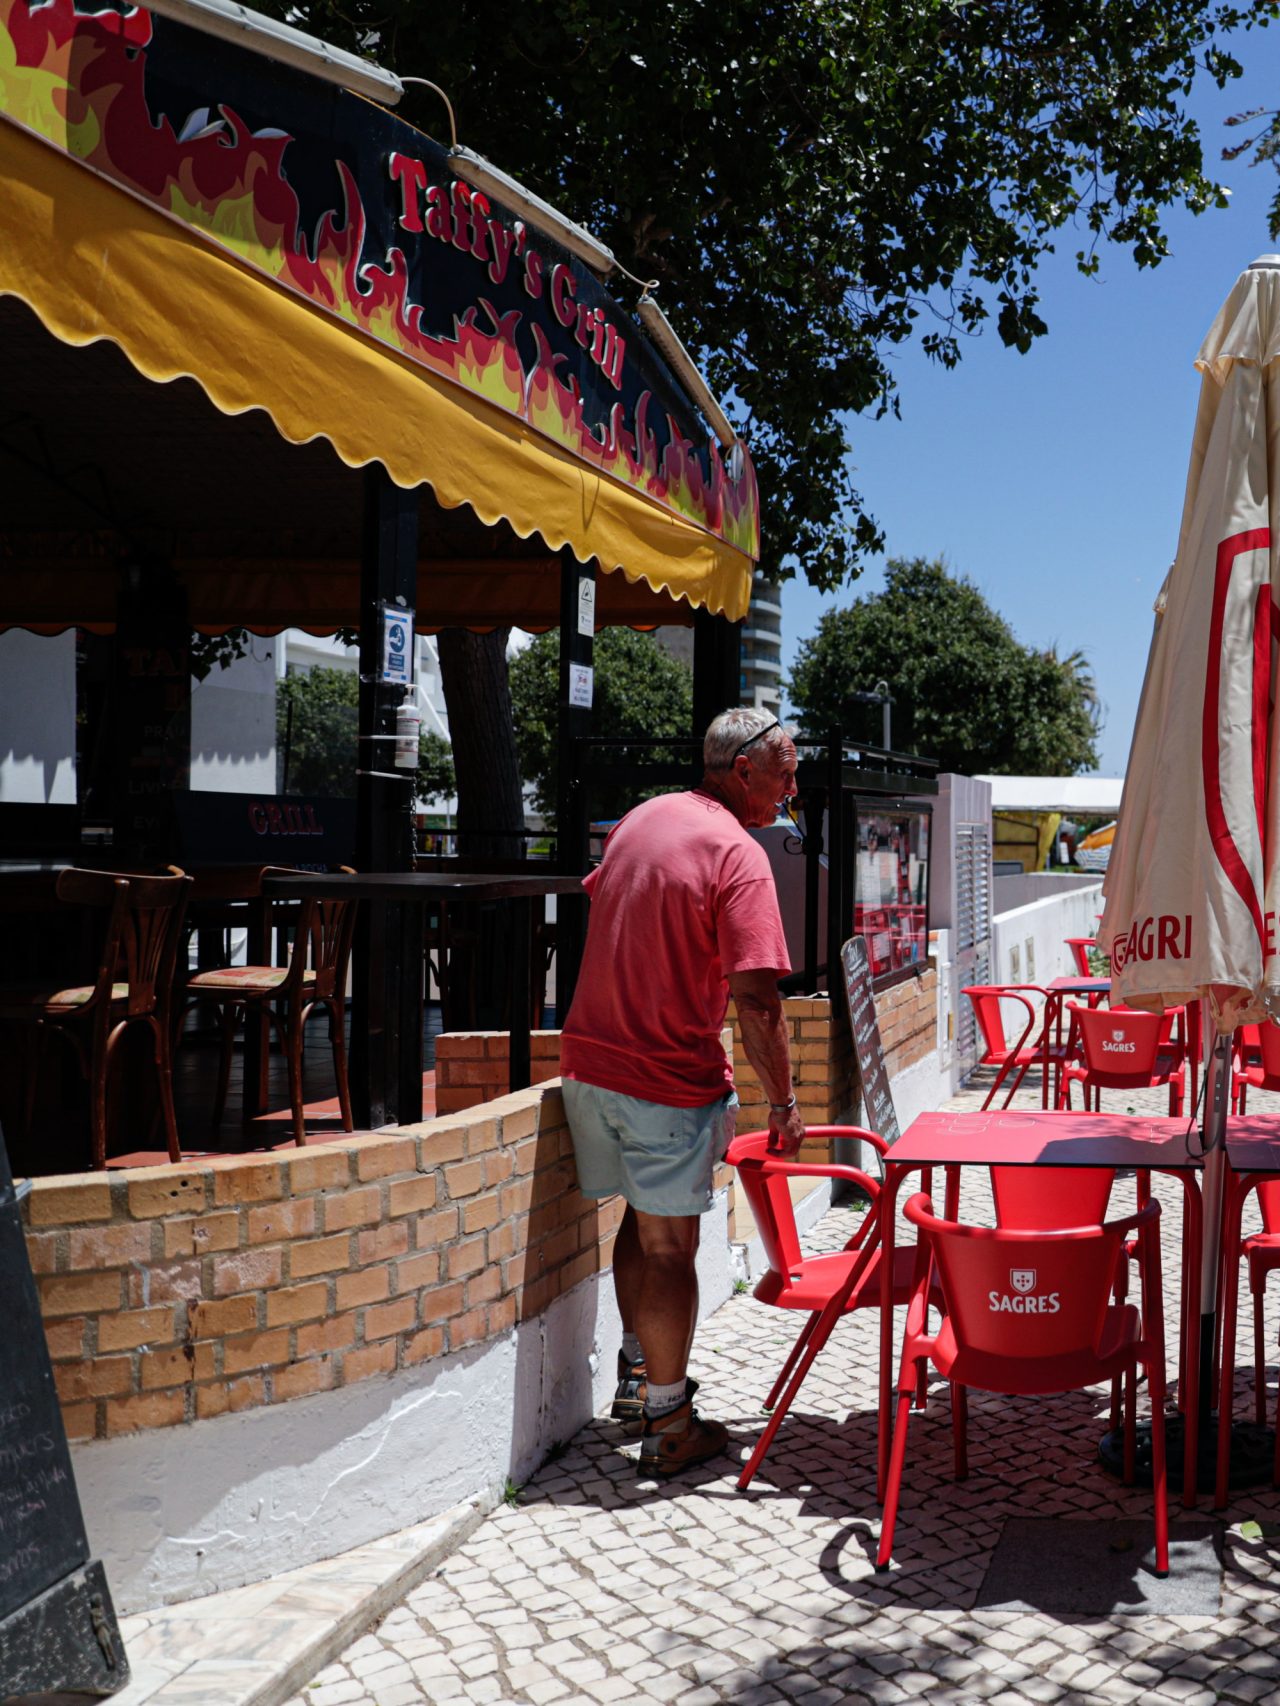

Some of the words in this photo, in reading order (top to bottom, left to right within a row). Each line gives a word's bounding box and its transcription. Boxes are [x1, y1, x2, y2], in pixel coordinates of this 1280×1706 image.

[389, 152, 544, 300] Taffy's
[550, 263, 627, 392] Grill
[247, 801, 324, 836] GRILL
[1102, 1041, 1136, 1053] SAGRES
[988, 1291, 1061, 1314] SAGRES
